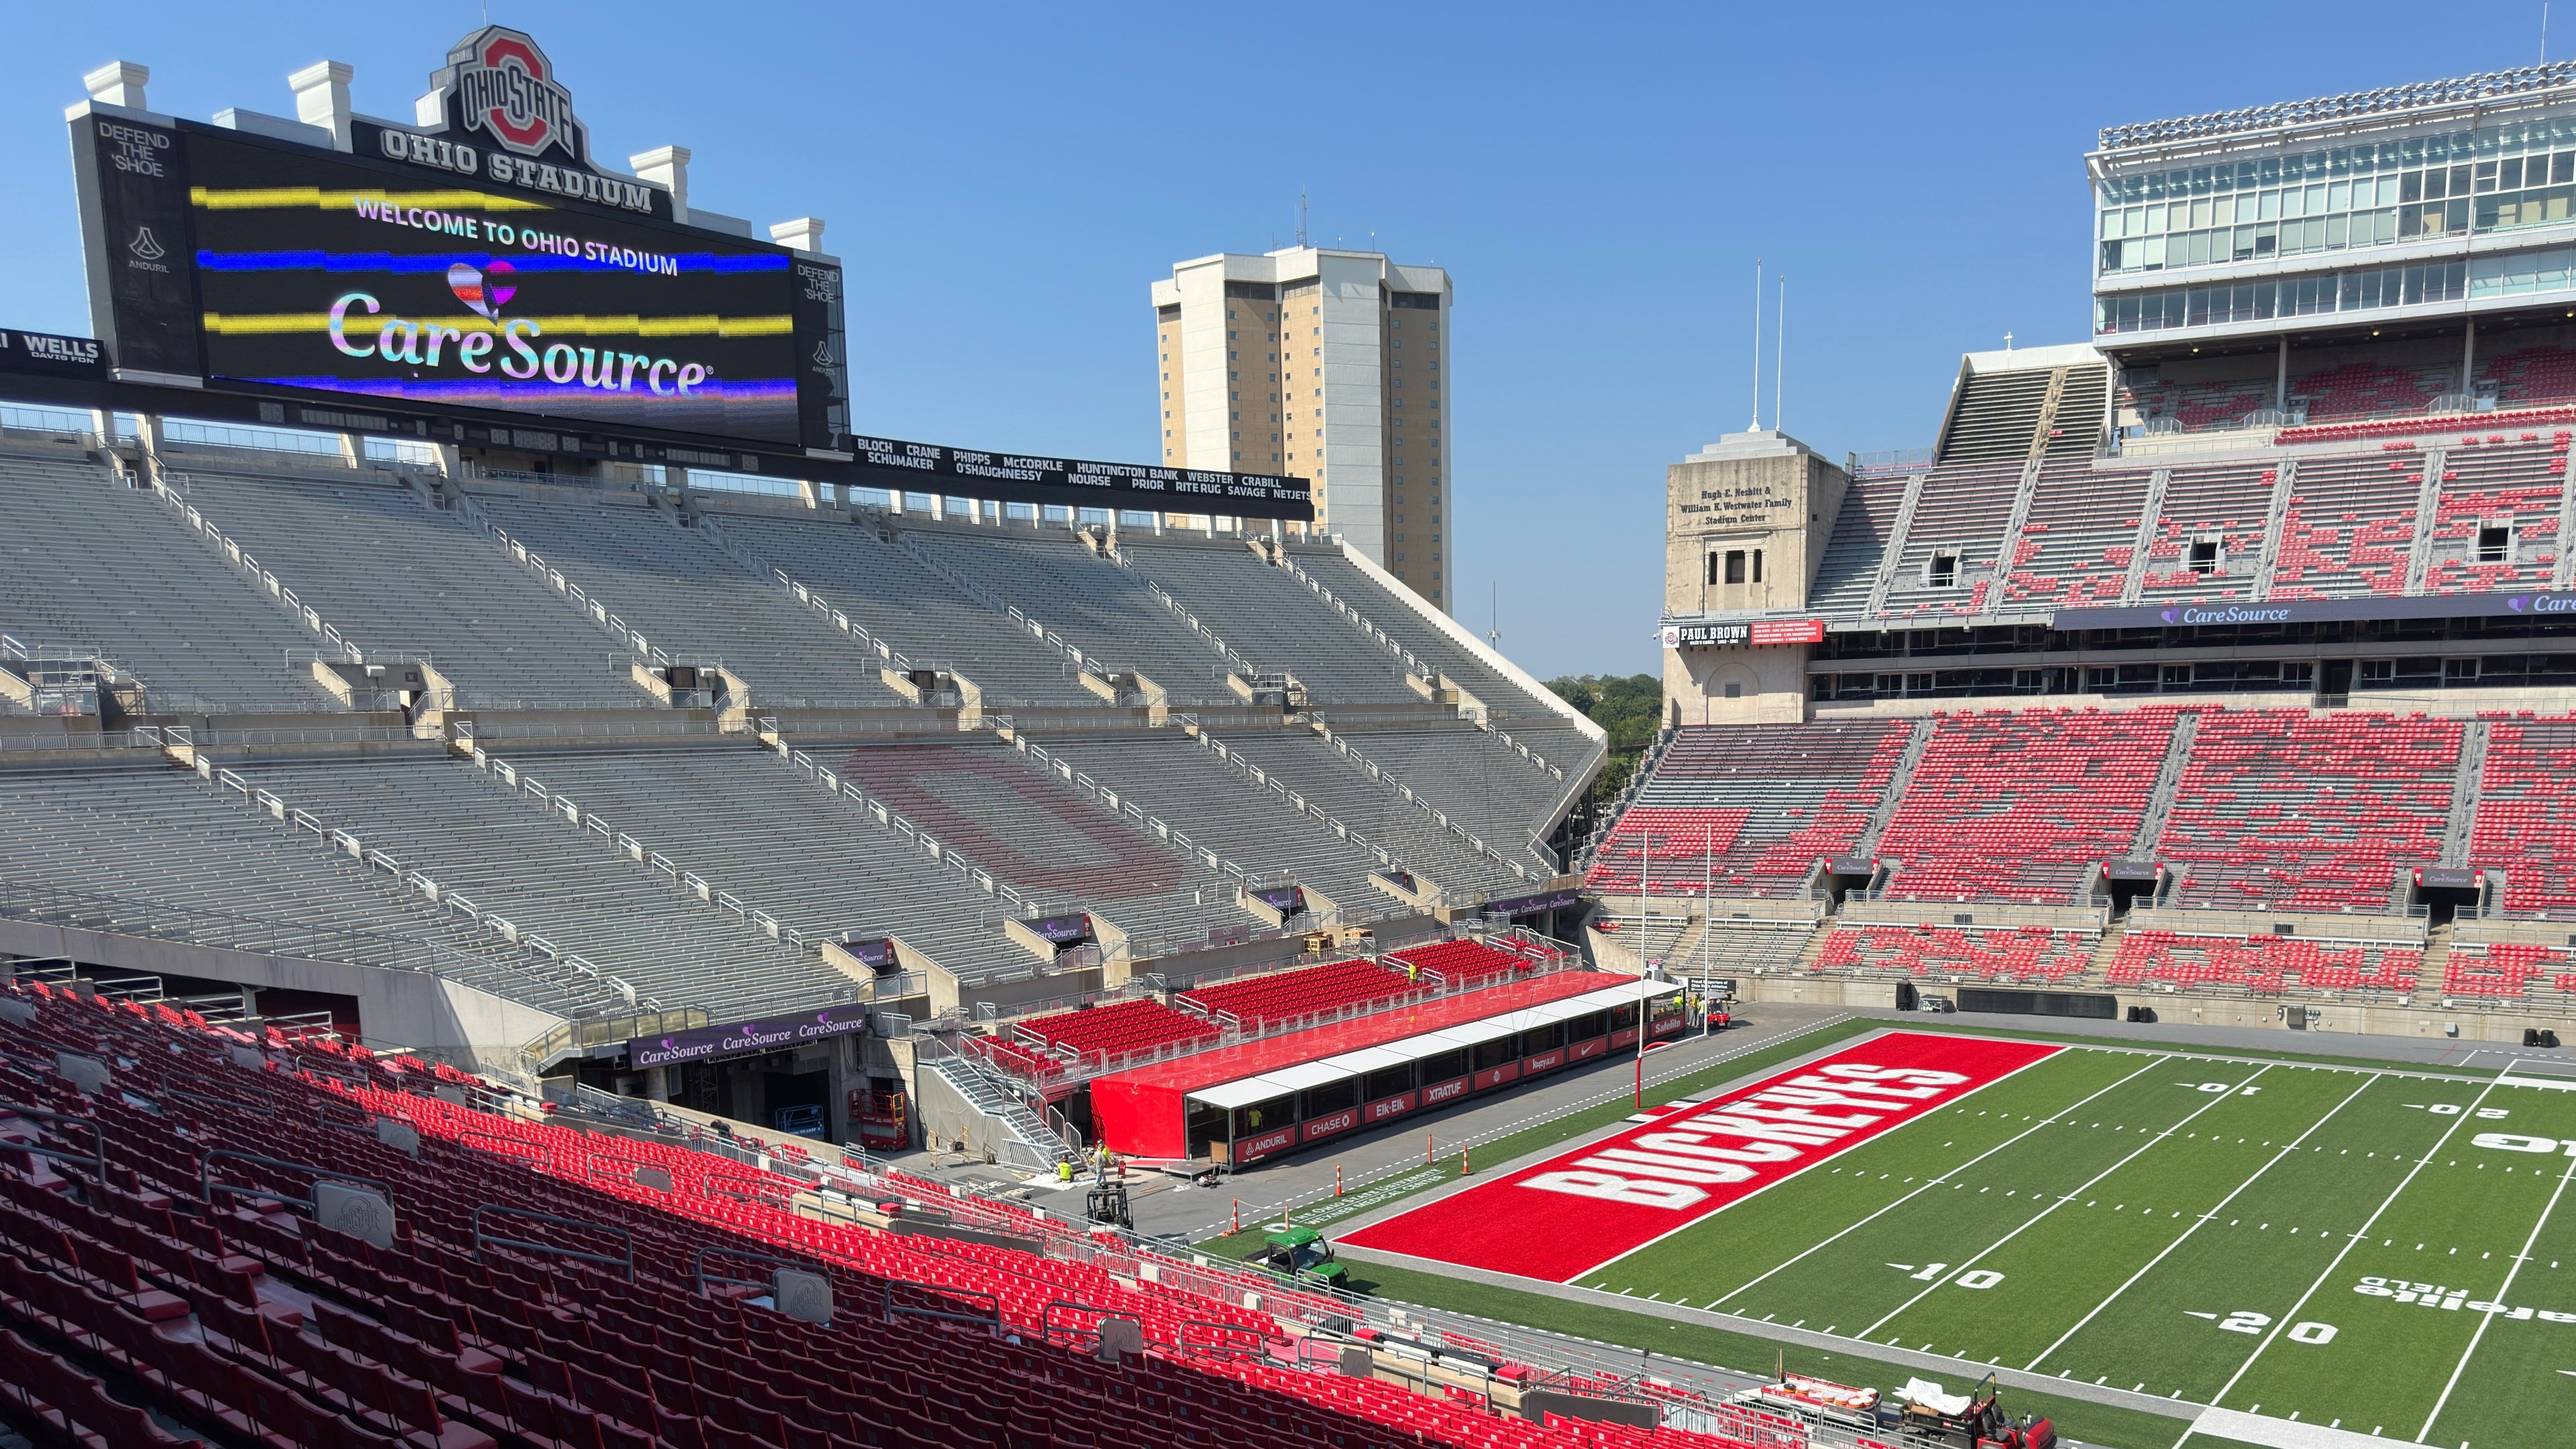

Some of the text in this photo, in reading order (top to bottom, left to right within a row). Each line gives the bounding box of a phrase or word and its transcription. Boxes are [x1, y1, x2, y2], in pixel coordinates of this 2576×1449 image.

[100, 123, 169, 149] DEFEND
[119, 141, 154, 162] THE
[111, 152, 163, 177] 'SHOE
[380, 129, 652, 214] OHIO STADIUM
[355, 196, 678, 276] WELCOME TO OHIO STADIUM
[129, 260, 170, 273] ANDURIL
[798, 264, 839, 282] DEFEND
[808, 278, 829, 292] THE
[23, 335, 99, 358] WELLS
[32, 352, 68, 361] DAVIS
[857, 438, 1281, 488] BLOCH CRANE PHIPPS McCORKLE HUNTINGTON BANK WEBSTER CRABILL
[867, 452, 1311, 500] SCHUMAKER O'SHAUGHNESSY NOURSE PRIOR RITE RUG SAVAGE NETJETS
[1701, 490, 1721, 500] Hugh
[1735, 488, 1762, 497] Nesbitt
[1765, 486, 1771, 494] &
[1680, 504, 1711, 513] William
[1723, 502, 1762, 511] Westwater
[1765, 498, 1792, 508] Family
[1705, 515, 1766, 525] Stadium Center
[2183, 606, 2289, 625] CareSource
[1680, 627, 1707, 641] PAUL
[1710, 626, 1748, 639] BROWN
[1655, 1018, 1680, 1033] Safelite
[640, 1019, 862, 1064] CareSource CareSource CareSource
[1429, 1082, 1461, 1102] XTRATUF
[1311, 1117, 1341, 1136] CHASE
[1515, 1063, 1971, 1210] BUCKEYES
[1255, 1134, 1287, 1152] ANDURIL
[1358, 1189, 1405, 1208] MEDICAL
[1407, 1175, 1447, 1191] CENTER
[2360, 1276, 2469, 1299] FIELD
